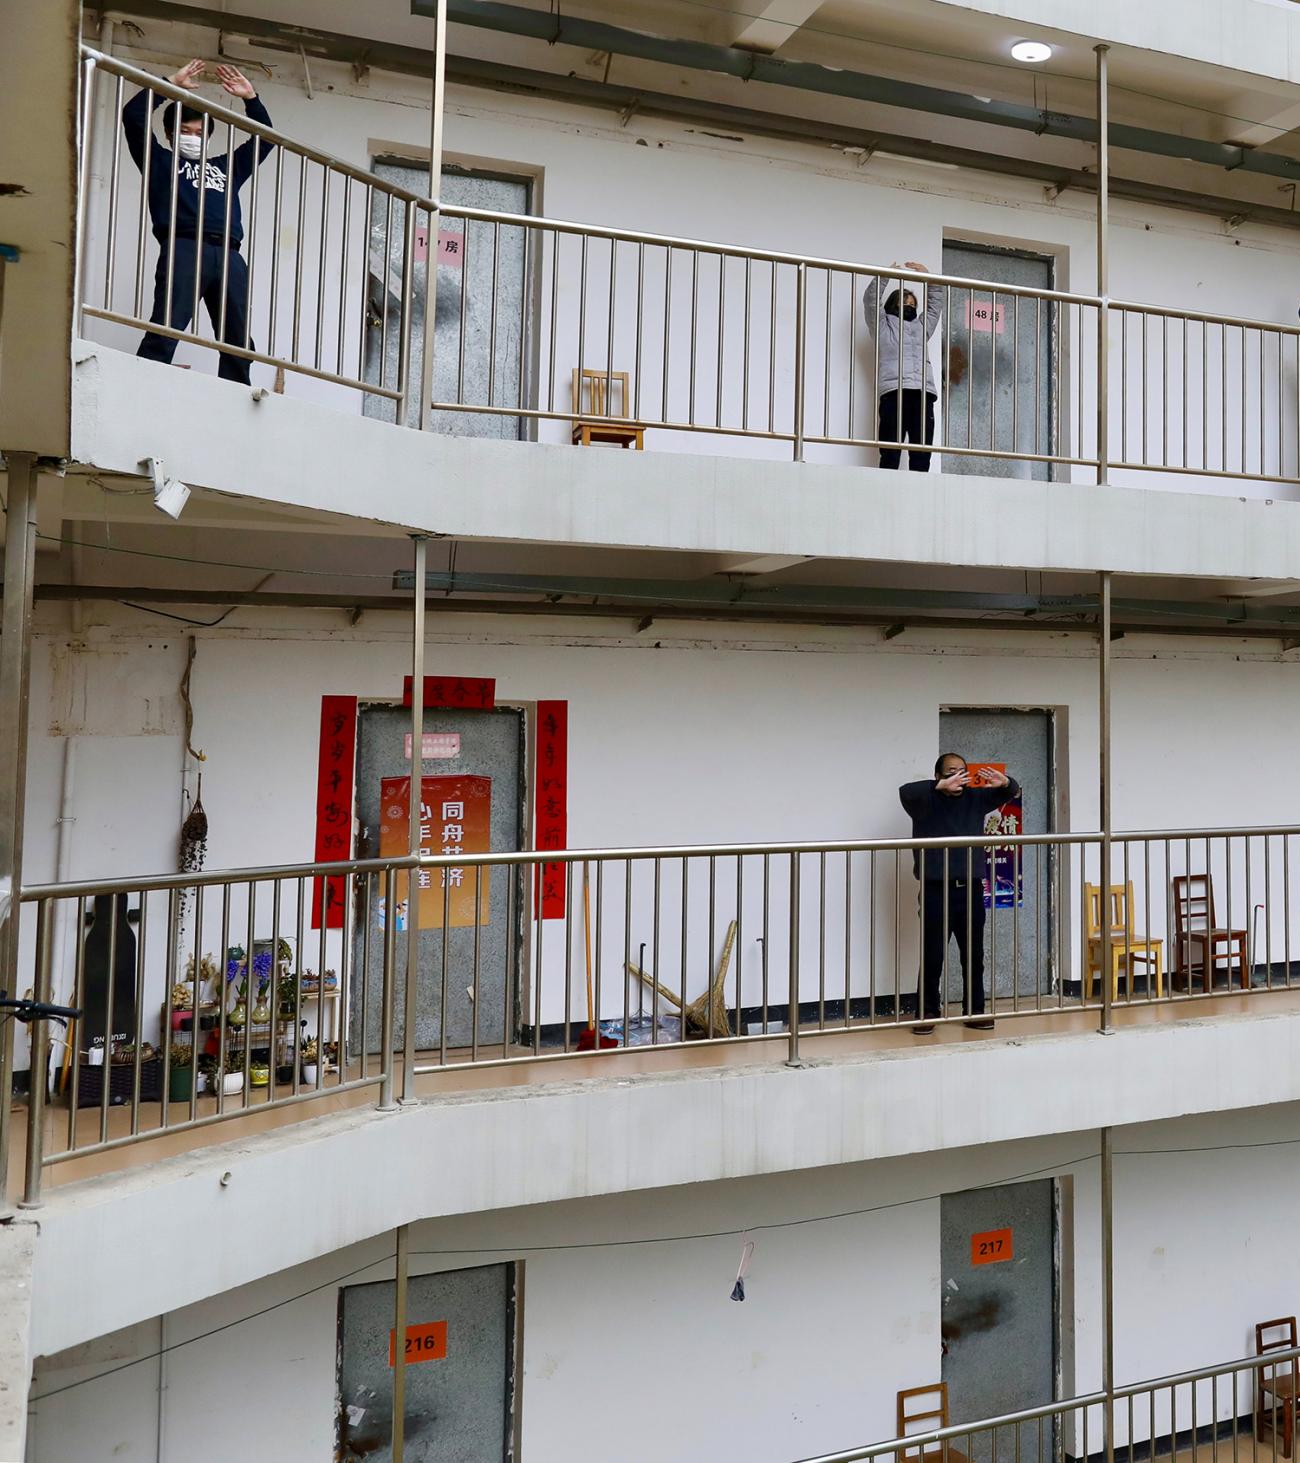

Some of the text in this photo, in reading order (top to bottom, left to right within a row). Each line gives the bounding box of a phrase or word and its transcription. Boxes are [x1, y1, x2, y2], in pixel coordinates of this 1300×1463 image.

[445, 241, 459, 254] 房
[979, 1239, 1003, 1255] 217
[405, 1336, 434, 1353] 216
